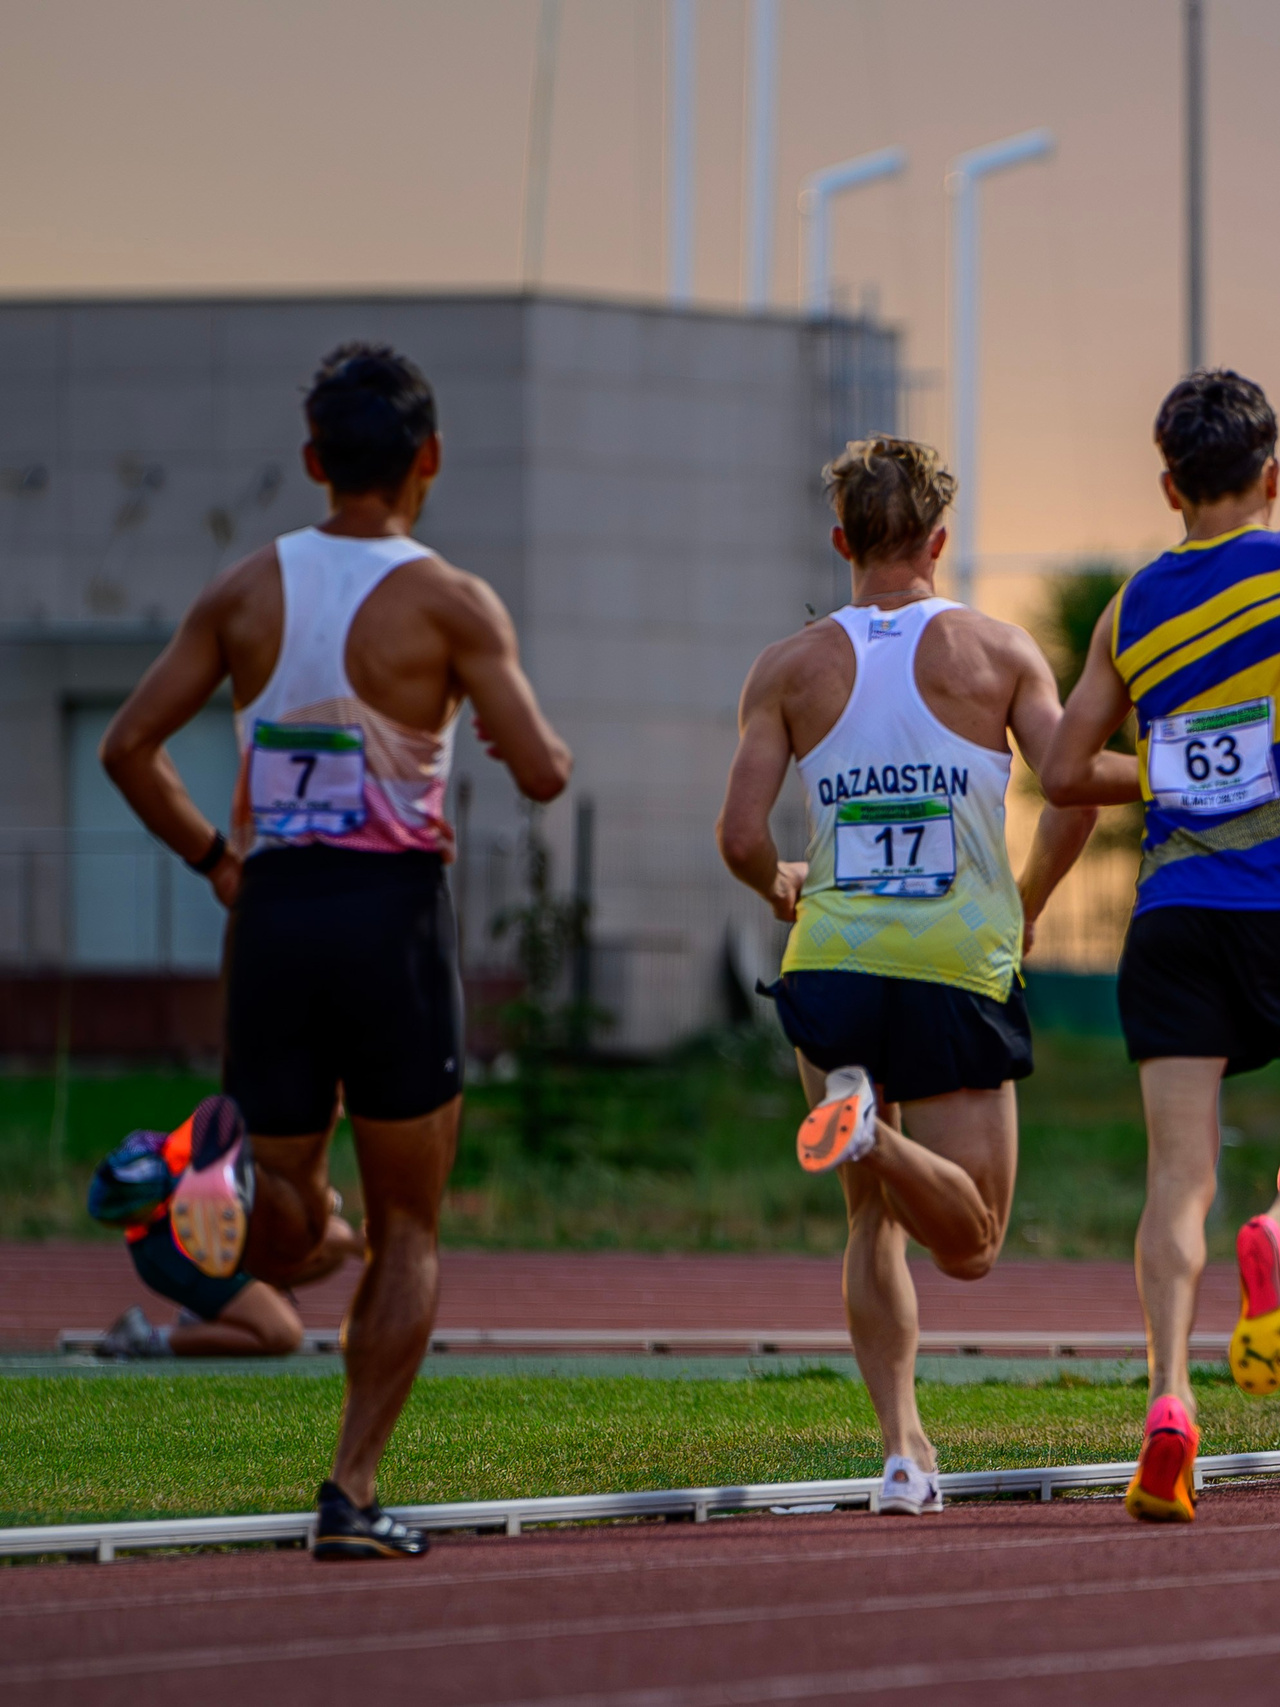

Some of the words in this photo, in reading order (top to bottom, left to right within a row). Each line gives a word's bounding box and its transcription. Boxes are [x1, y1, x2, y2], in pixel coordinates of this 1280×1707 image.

[290, 756, 317, 799] 7
[1185, 735, 1241, 781] 63
[818, 763, 968, 806] QAZAQSTAN
[875, 825, 925, 867] 17
